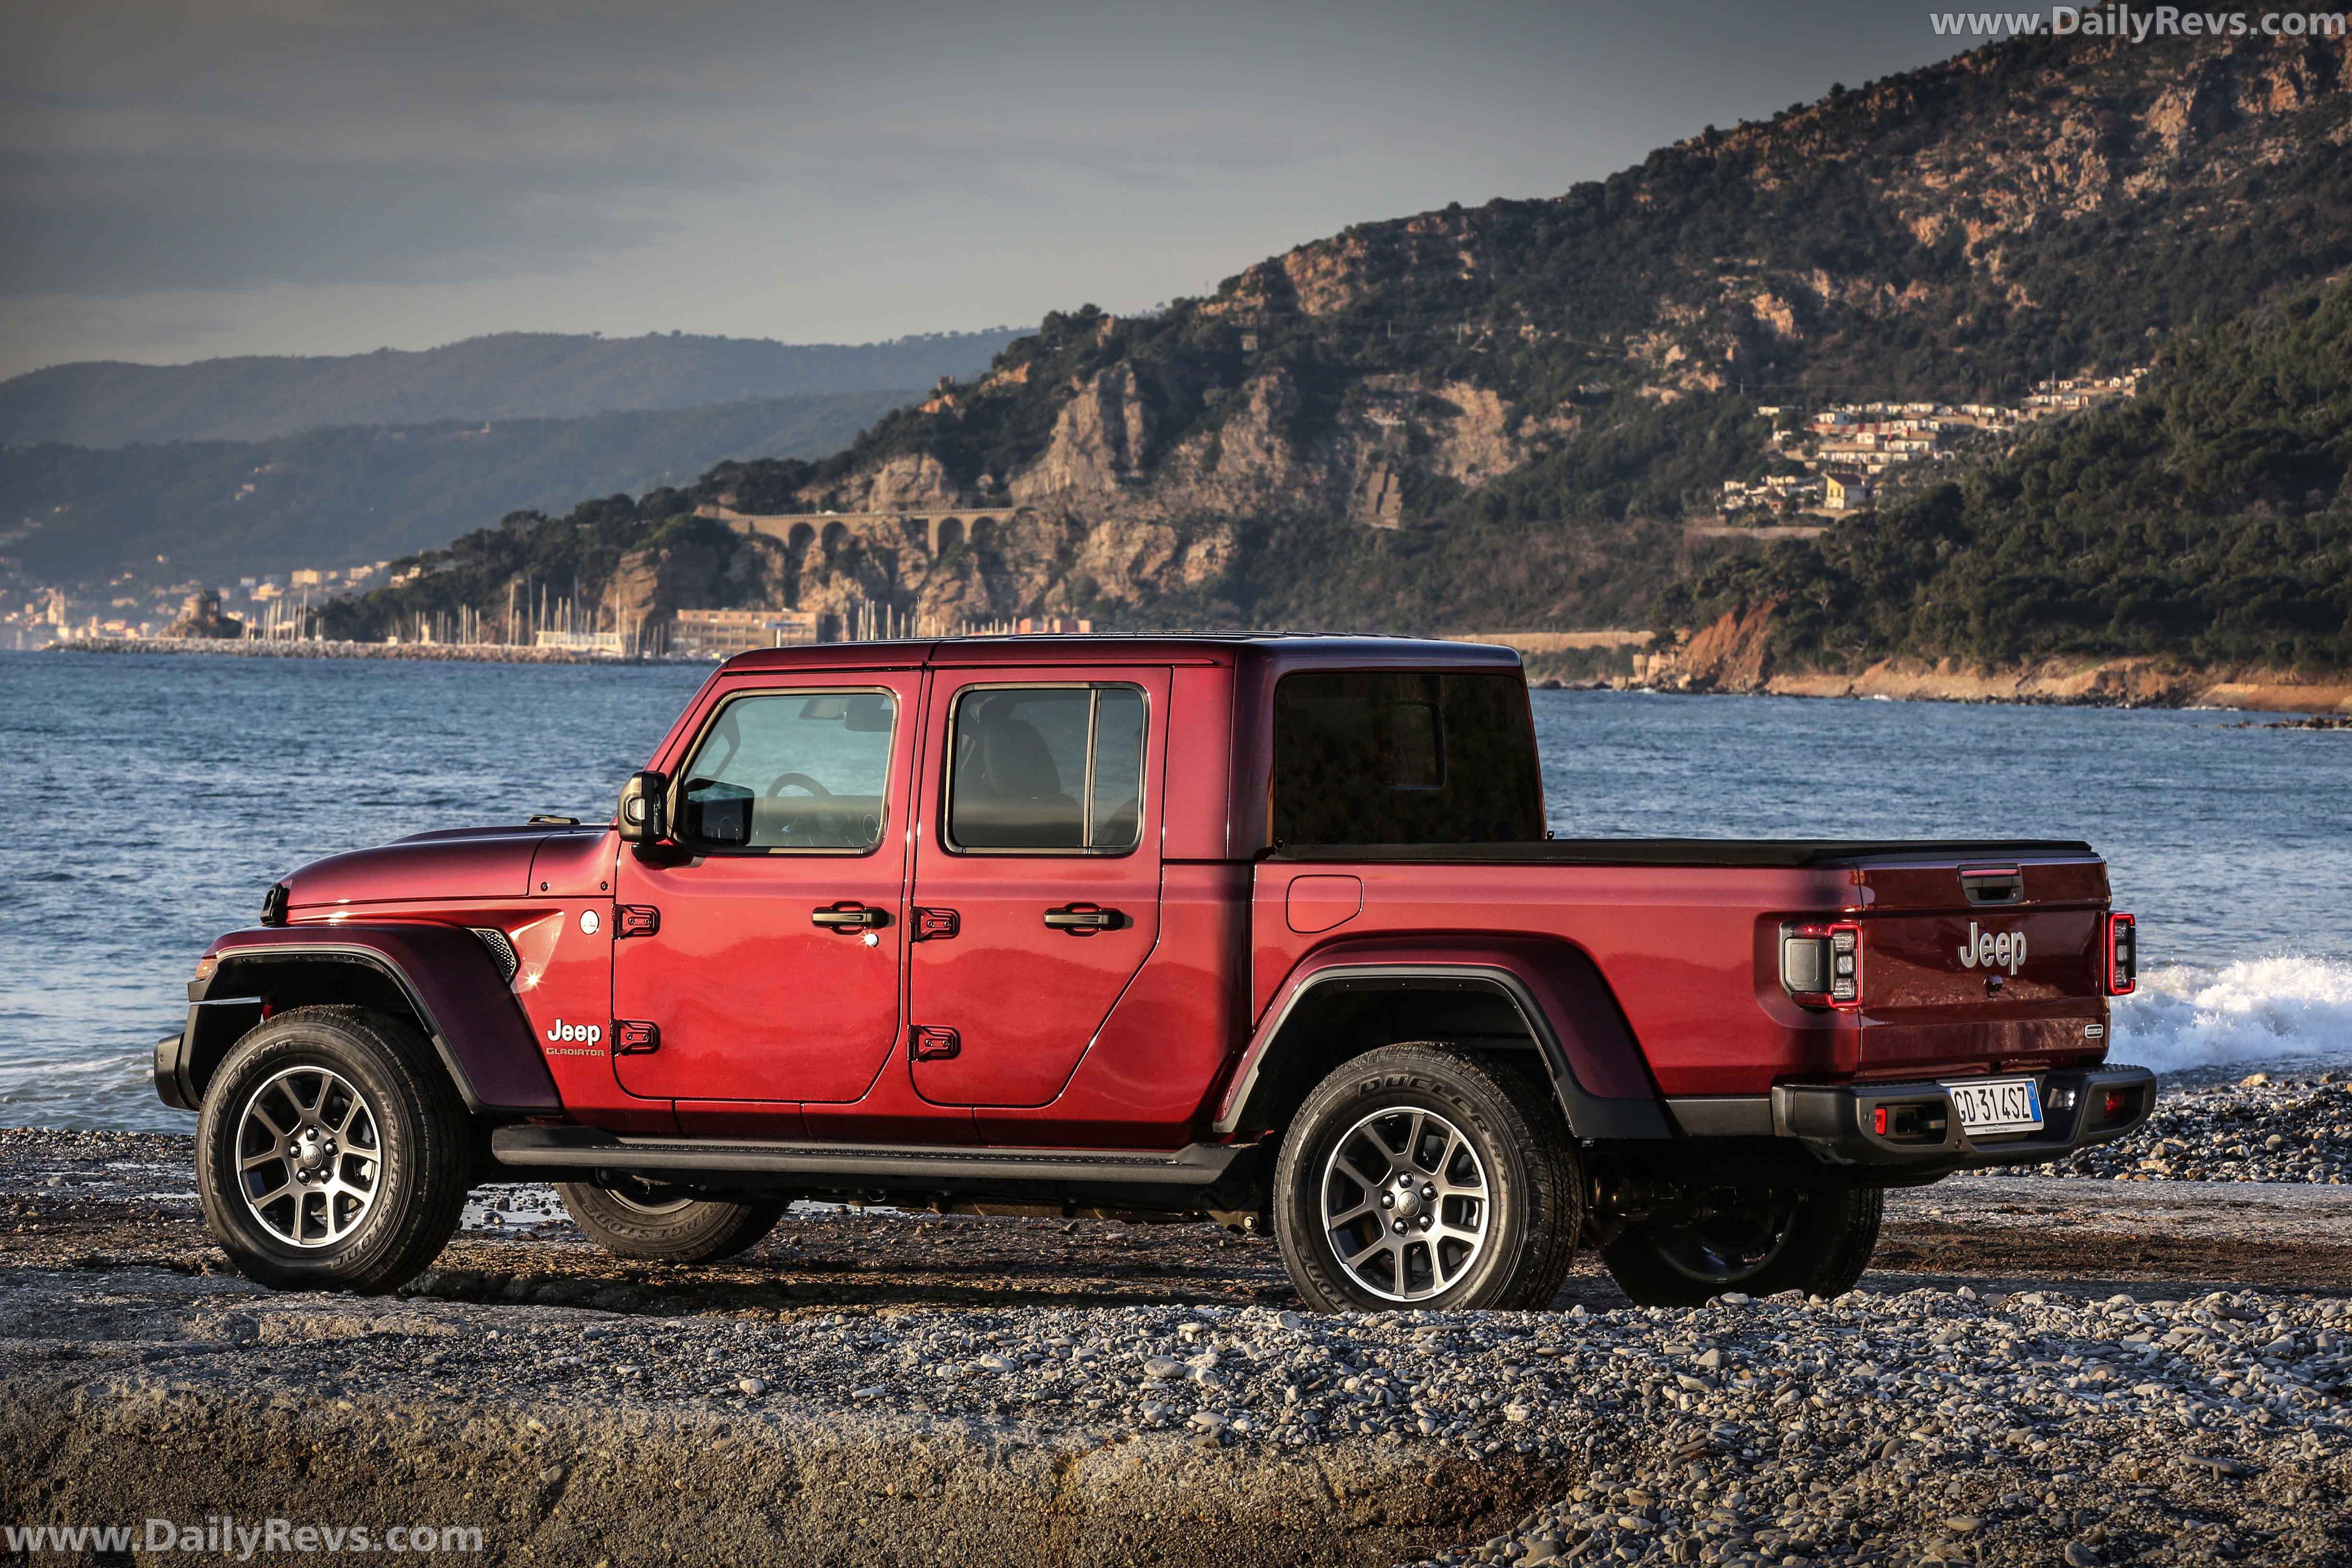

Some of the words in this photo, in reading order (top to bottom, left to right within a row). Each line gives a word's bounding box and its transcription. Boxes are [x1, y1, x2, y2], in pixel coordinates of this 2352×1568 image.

[1959, 922, 2027, 976] Jeep
[546, 1047, 605, 1057] GLADIATOR
[547, 1018, 601, 1046] Jeep
[1358, 1074, 1492, 1135] DUELER
[330, 1091, 402, 1270] BRIDGESTONE
